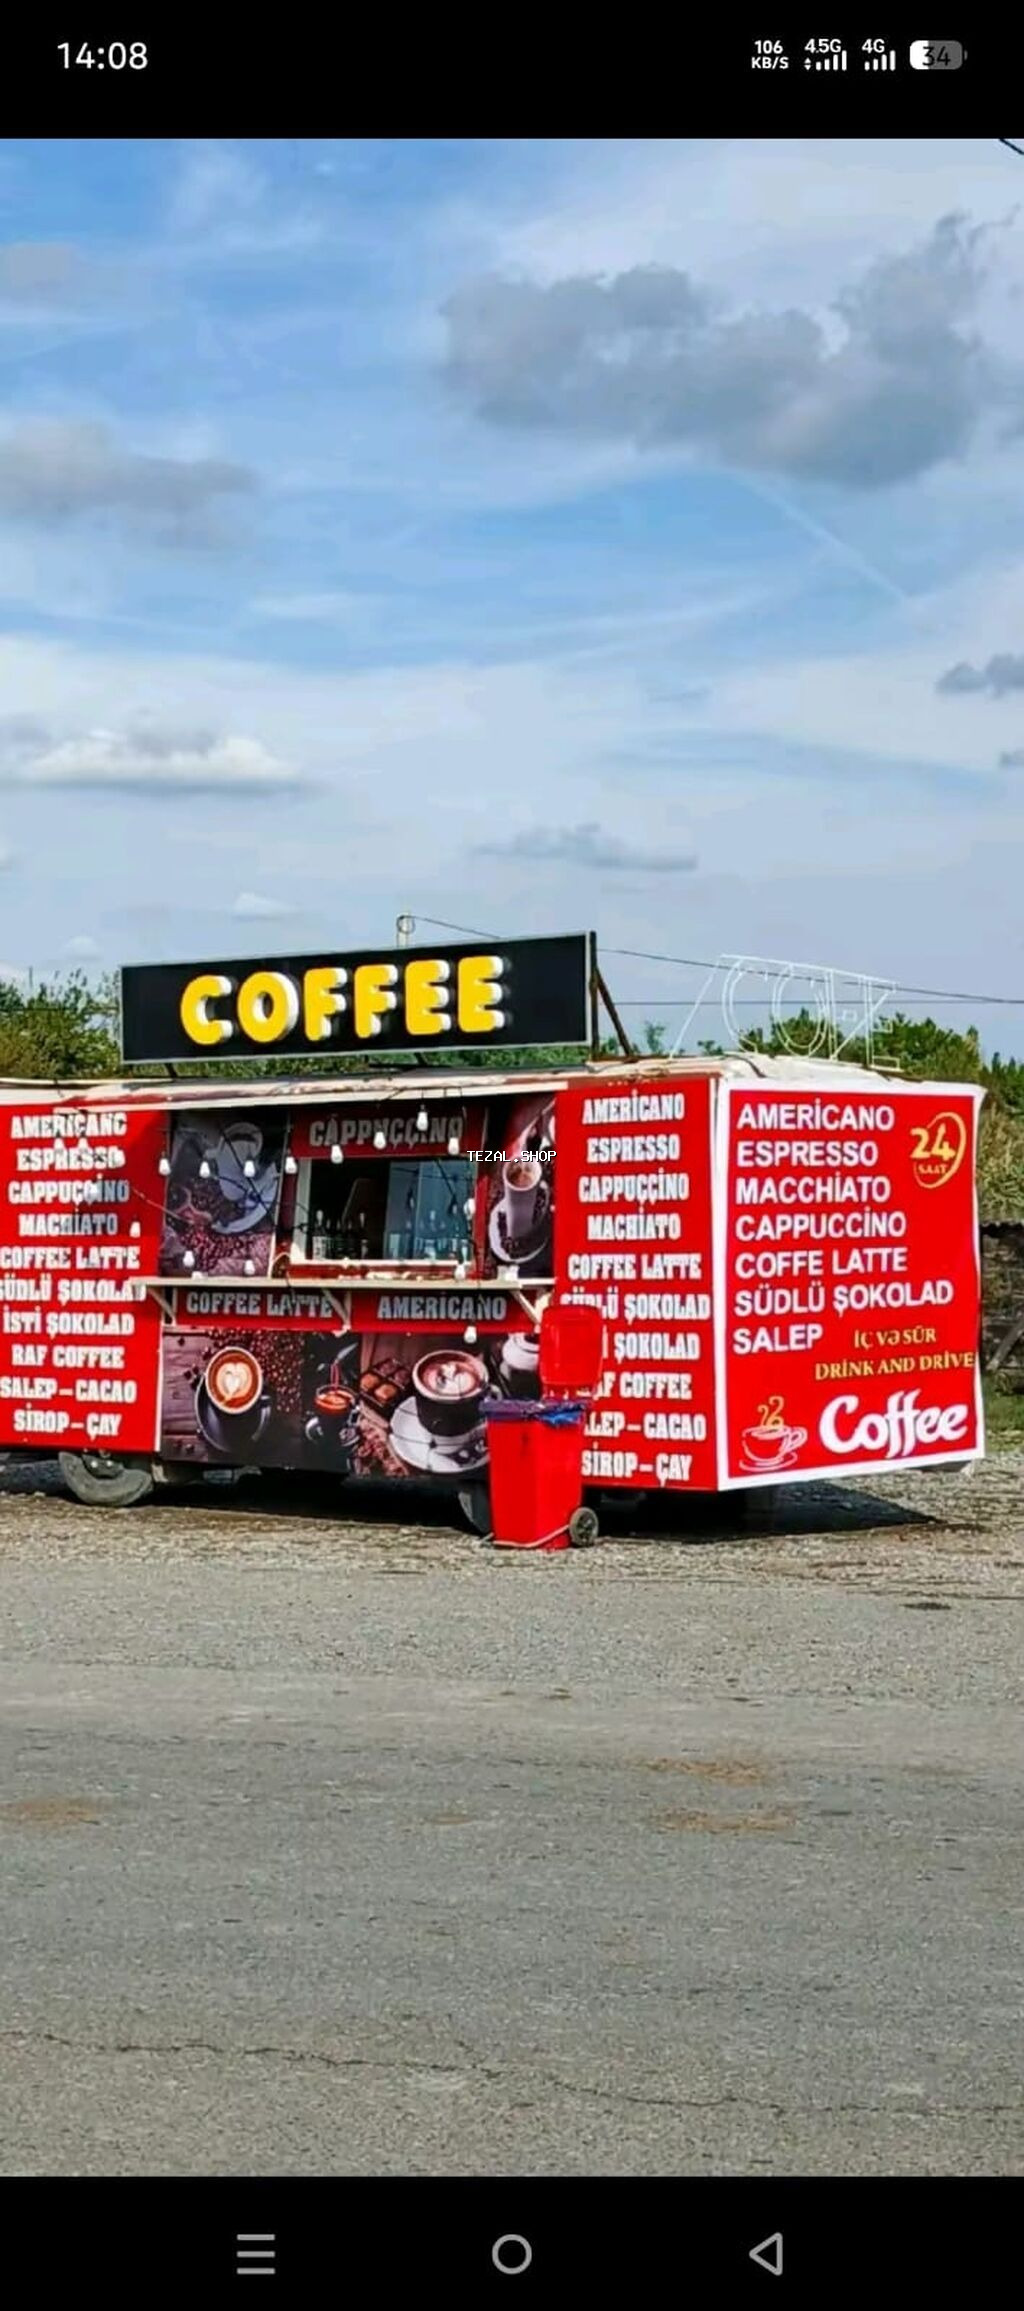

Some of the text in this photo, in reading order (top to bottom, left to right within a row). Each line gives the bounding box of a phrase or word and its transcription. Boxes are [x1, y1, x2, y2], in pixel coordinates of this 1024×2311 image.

[181, 955, 505, 1045] COFFEE
[582, 1089, 685, 1124] AMERİCANO
[736, 1097, 895, 1131] AMERİCANO
[586, 1134, 681, 1163] ESPRESSO
[737, 1141, 878, 1167] ESPRESSO
[910, 1123, 956, 1161] 24
[16, 1145, 125, 1171] ESPRESSO
[578, 1167, 690, 1207] CAPPUÇÇİNO
[735, 1171, 891, 1205] MACCHİATO
[587, 1206, 682, 1241] MACHİATO
[735, 1206, 906, 1242] CAPPUCCİNO
[0, 1246, 140, 1269] COFFEE LATTE
[567, 1253, 702, 1281] COFFEE LATTE
[735, 1247, 908, 1278] COFFE LATTE
[57, 1279, 147, 1306] ŞOKOLAD
[186, 1292, 334, 1318] COFFEE LATTE
[377, 1292, 507, 1320] AMERİCANO
[734, 1279, 954, 1317] SÜDLÜ ŞOKOLAD
[3, 1304, 135, 1340] İSTİ ŞOKOLAD
[624, 1294, 711, 1325] ŞOKOLAD
[614, 1332, 700, 1364] ŞOKOLAD
[733, 1323, 823, 1354] SALEP
[11, 1343, 125, 1369] RAF COFFEE
[815, 1350, 975, 1381] DRİNK AND DRİVE
[0, 1376, 57, 1399] SALEP
[75, 1379, 137, 1403] CACAO
[620, 1372, 692, 1399] COFFEE
[13, 1402, 69, 1433] SİROP
[86, 1412, 122, 1442] ÇAY
[643, 1413, 706, 1441] CACAO
[818, 1388, 968, 1459] Coffee
[581, 1442, 638, 1478] SİROP
[655, 1453, 692, 1487] ÇAY
